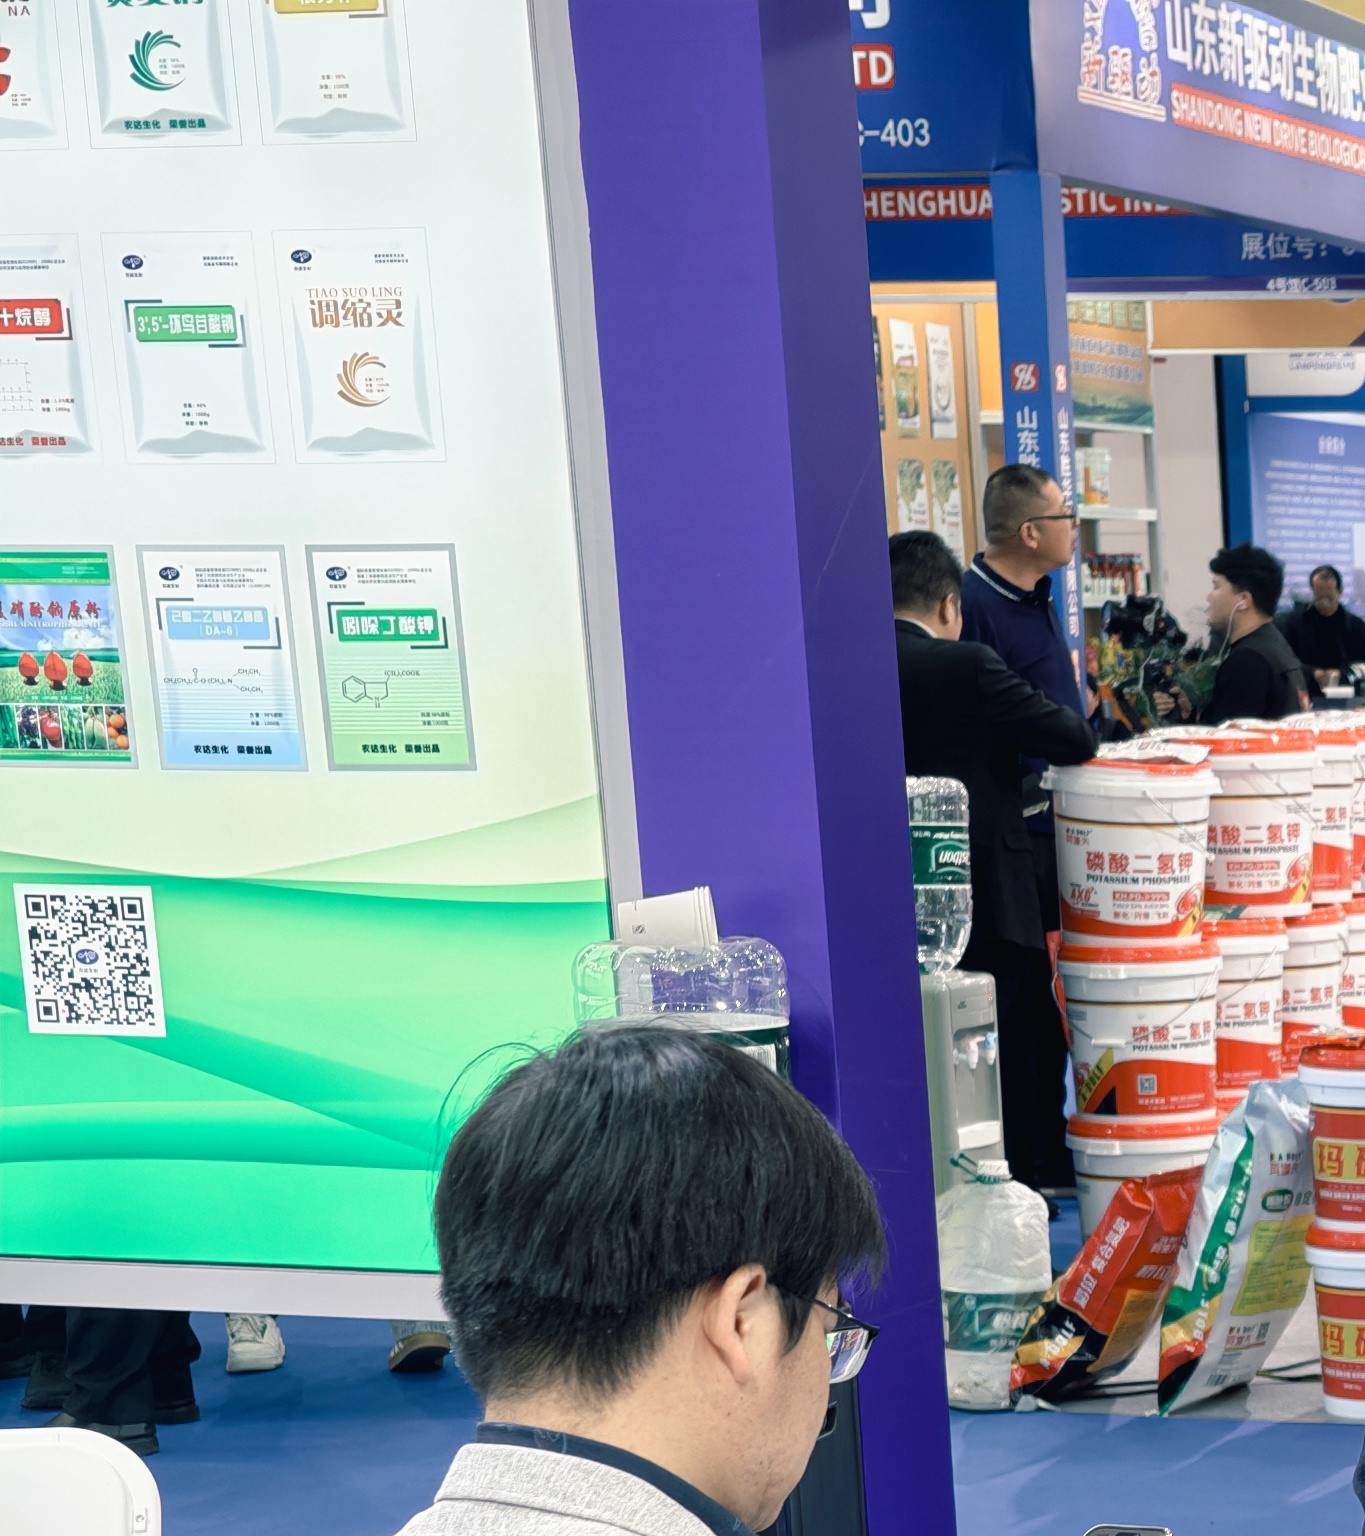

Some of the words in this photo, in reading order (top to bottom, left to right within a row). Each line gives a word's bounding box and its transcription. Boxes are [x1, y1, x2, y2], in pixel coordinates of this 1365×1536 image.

[1171, 90, 1243, 136] SHANDONG
[1245, 110, 1272, 143] NEW
[1273, 119, 1308, 153] DRIVE
[305, 287, 338, 298] TIAO
[342, 286, 368, 298] SUO
[370, 286, 402, 297] LING
[308, 298, 406, 329] 调缩灵
[342, 614, 434, 635] 吲哚丁酸钾
[1086, 851, 1193, 875] 磷酸二氢钾
